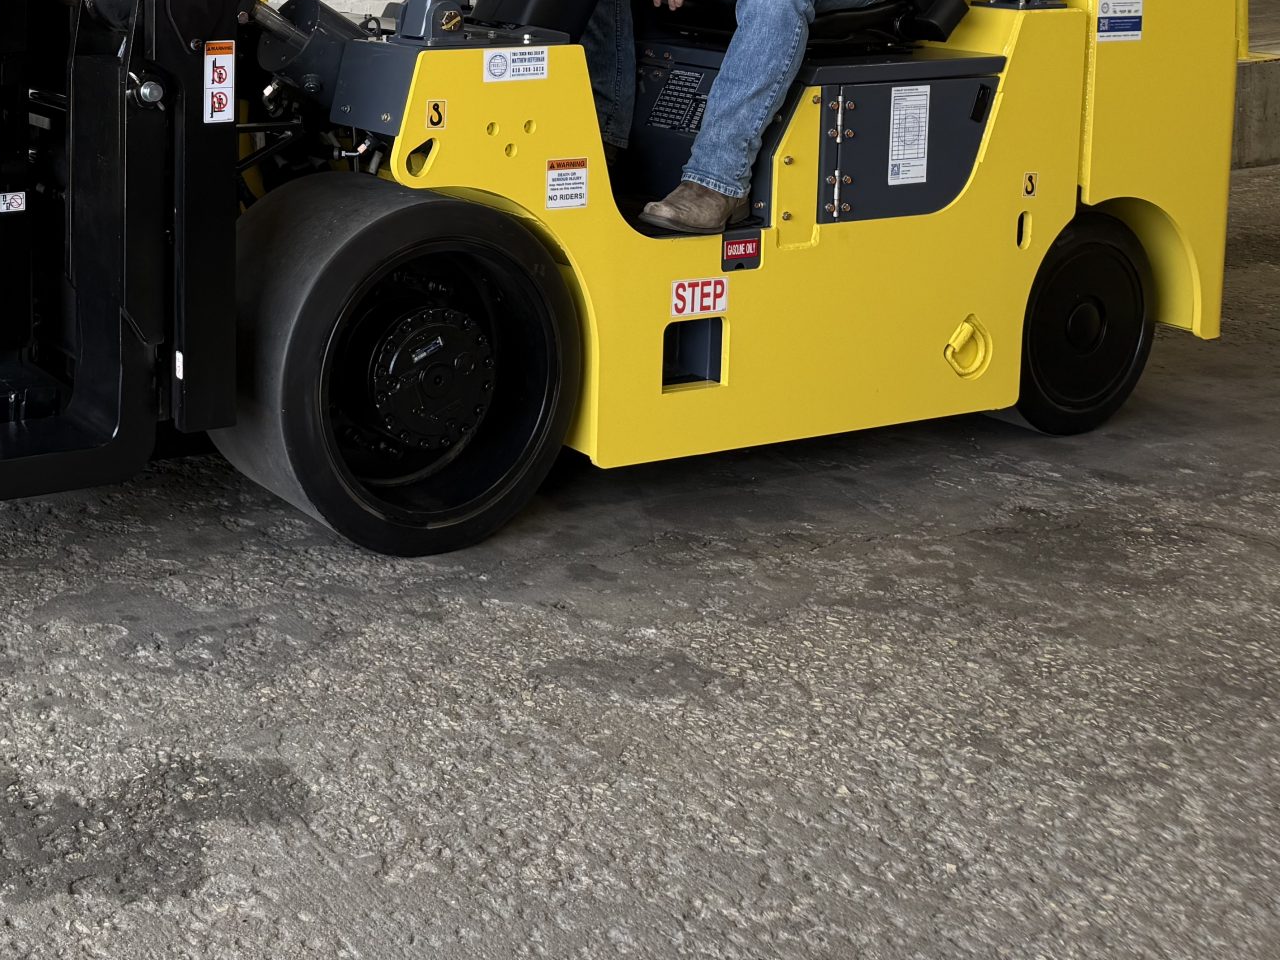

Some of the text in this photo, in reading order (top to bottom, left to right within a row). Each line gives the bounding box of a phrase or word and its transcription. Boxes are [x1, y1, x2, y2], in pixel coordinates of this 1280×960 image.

[556, 160, 585, 168] WARNING
[727, 242, 756, 256] GASOLINE ONLY
[674, 280, 725, 314] STEP
